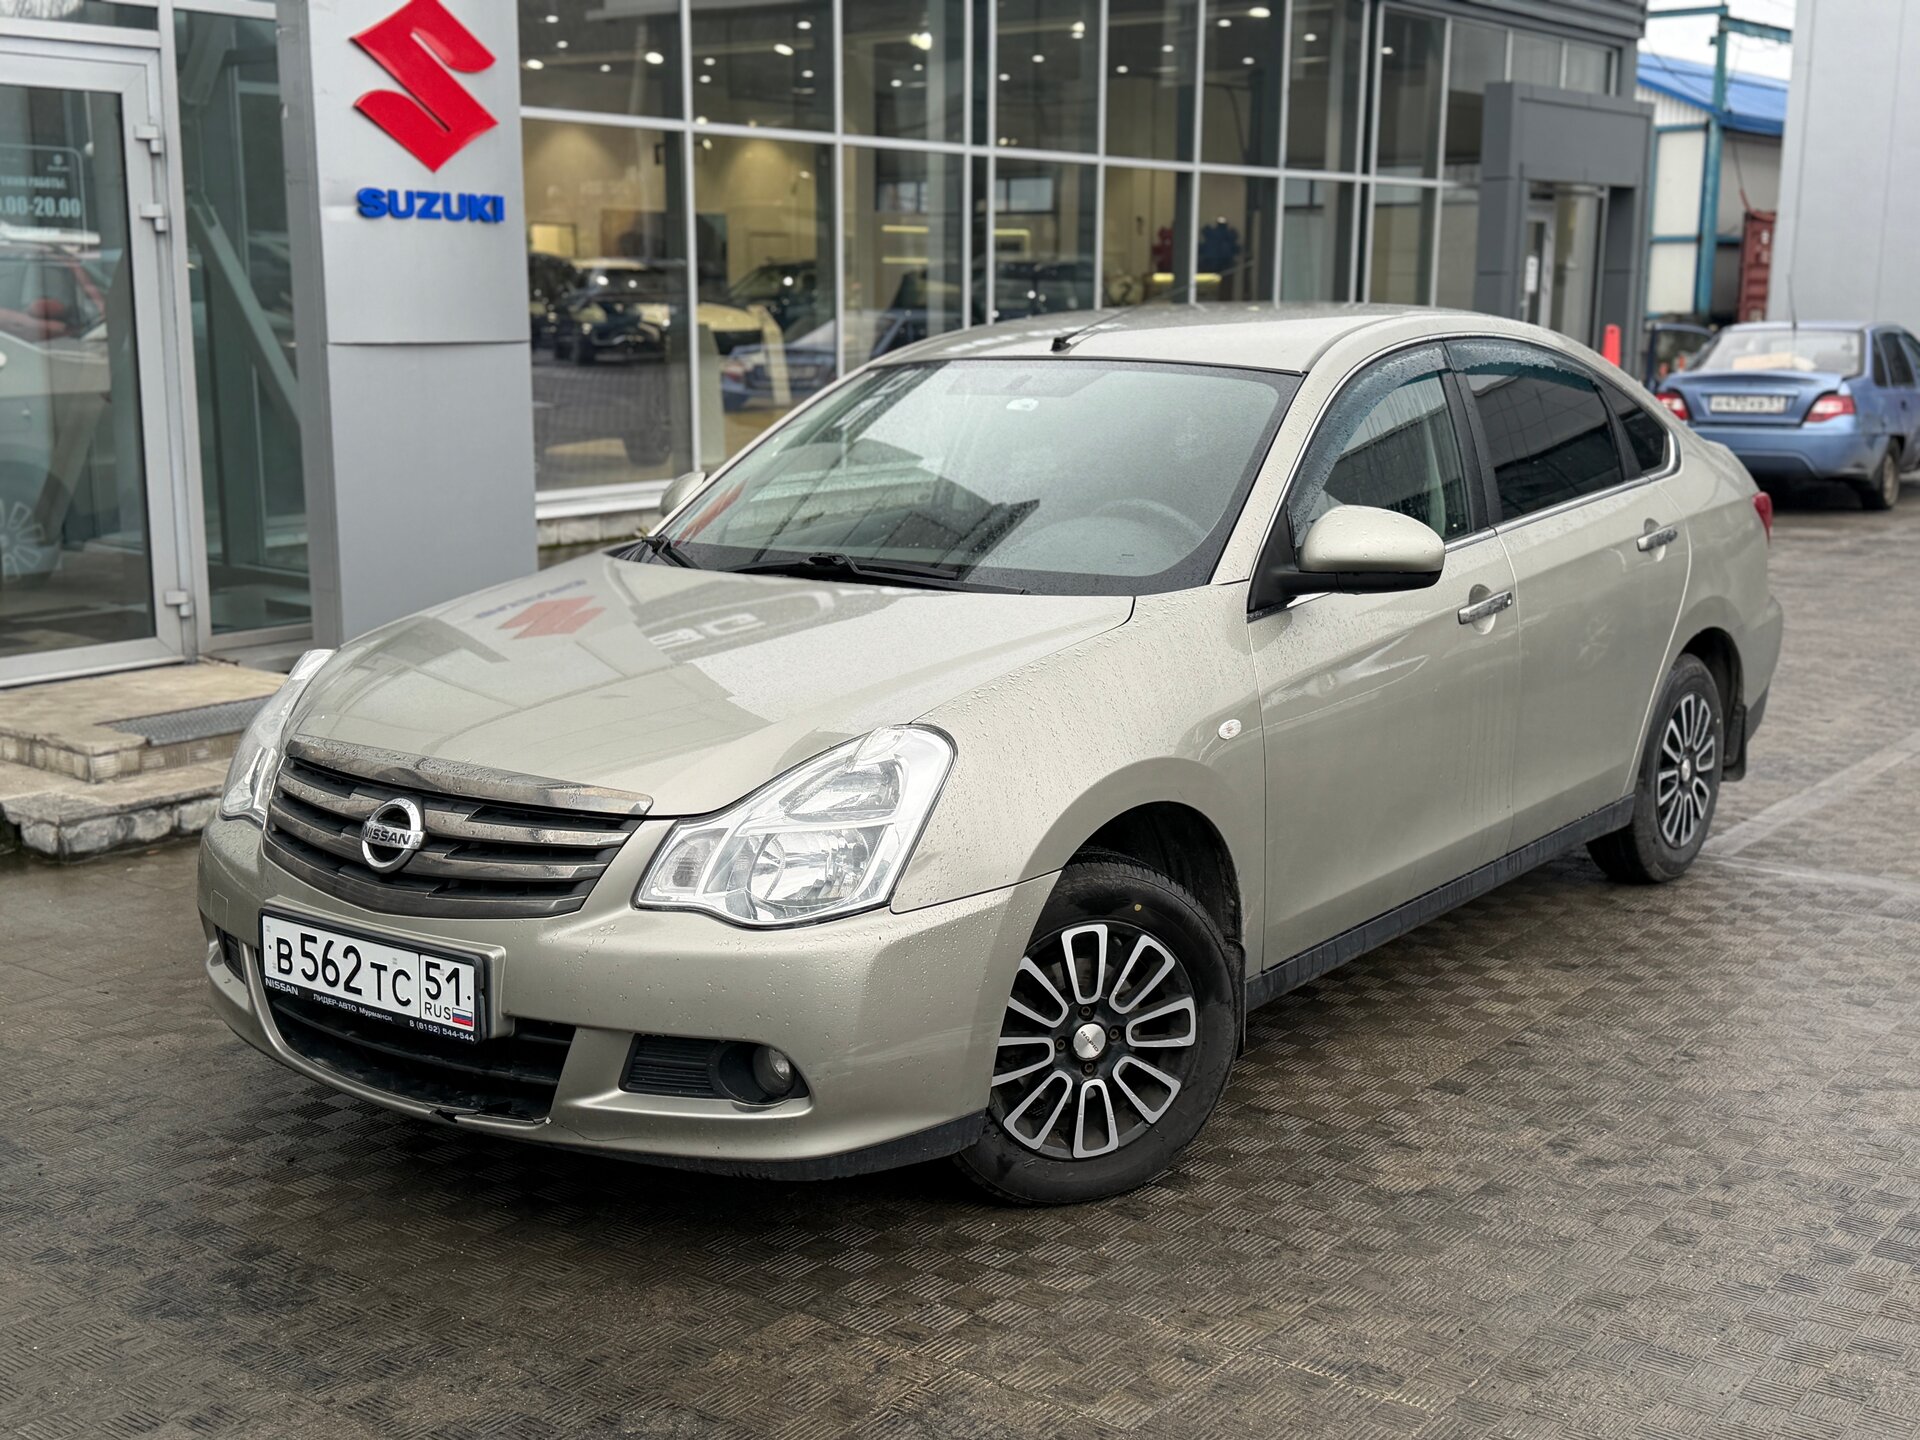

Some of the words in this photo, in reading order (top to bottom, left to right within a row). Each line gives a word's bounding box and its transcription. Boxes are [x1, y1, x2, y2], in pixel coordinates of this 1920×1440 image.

[0, 195, 81, 218] .00-20.00
[357, 188, 504, 223] SUZUKI
[362, 825, 411, 845] NISSAN
[265, 978, 299, 996] NISSAN
[425, 961, 460, 1006] 51
[313, 993, 357, 1012] ЛИДЕР-АВТО
[359, 1007, 393, 1022] Мурманск
[424, 1002, 452, 1020] RUS
[442, 1028, 475, 1041] 544-544
